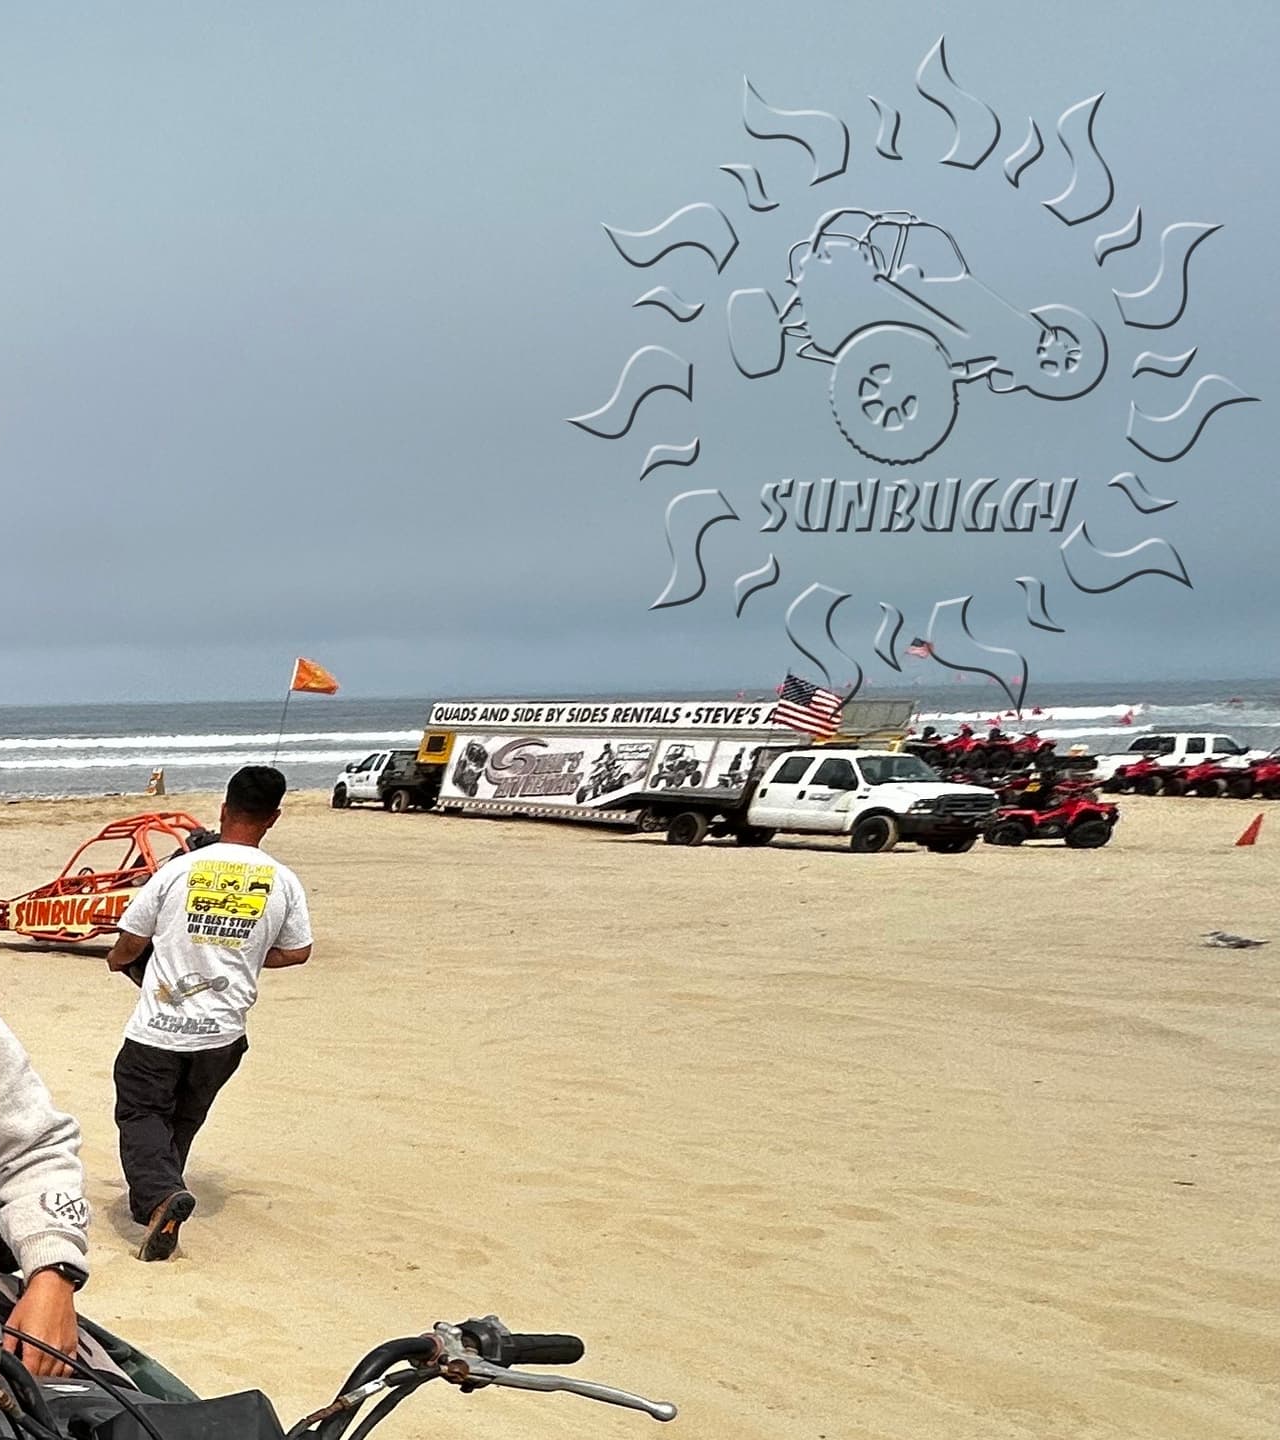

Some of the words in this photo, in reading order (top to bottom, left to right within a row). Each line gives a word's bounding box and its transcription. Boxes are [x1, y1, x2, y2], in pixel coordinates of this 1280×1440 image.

[434, 706, 478, 722] QUADS
[479, 706, 510, 722] AND
[511, 706, 542, 723] SIDE
[544, 707, 567, 723] BY
[566, 706, 610, 724] SIDES
[610, 706, 682, 724] RENTALS
[691, 706, 763, 725] STEVE'S
[187, 912, 205, 923] THE
[205, 914, 228, 926] BEST
[229, 917, 258, 930] STUFF
[187, 923, 201, 934] ON
[202, 925, 219, 936] THE
[219, 927, 252, 939] BEACH
